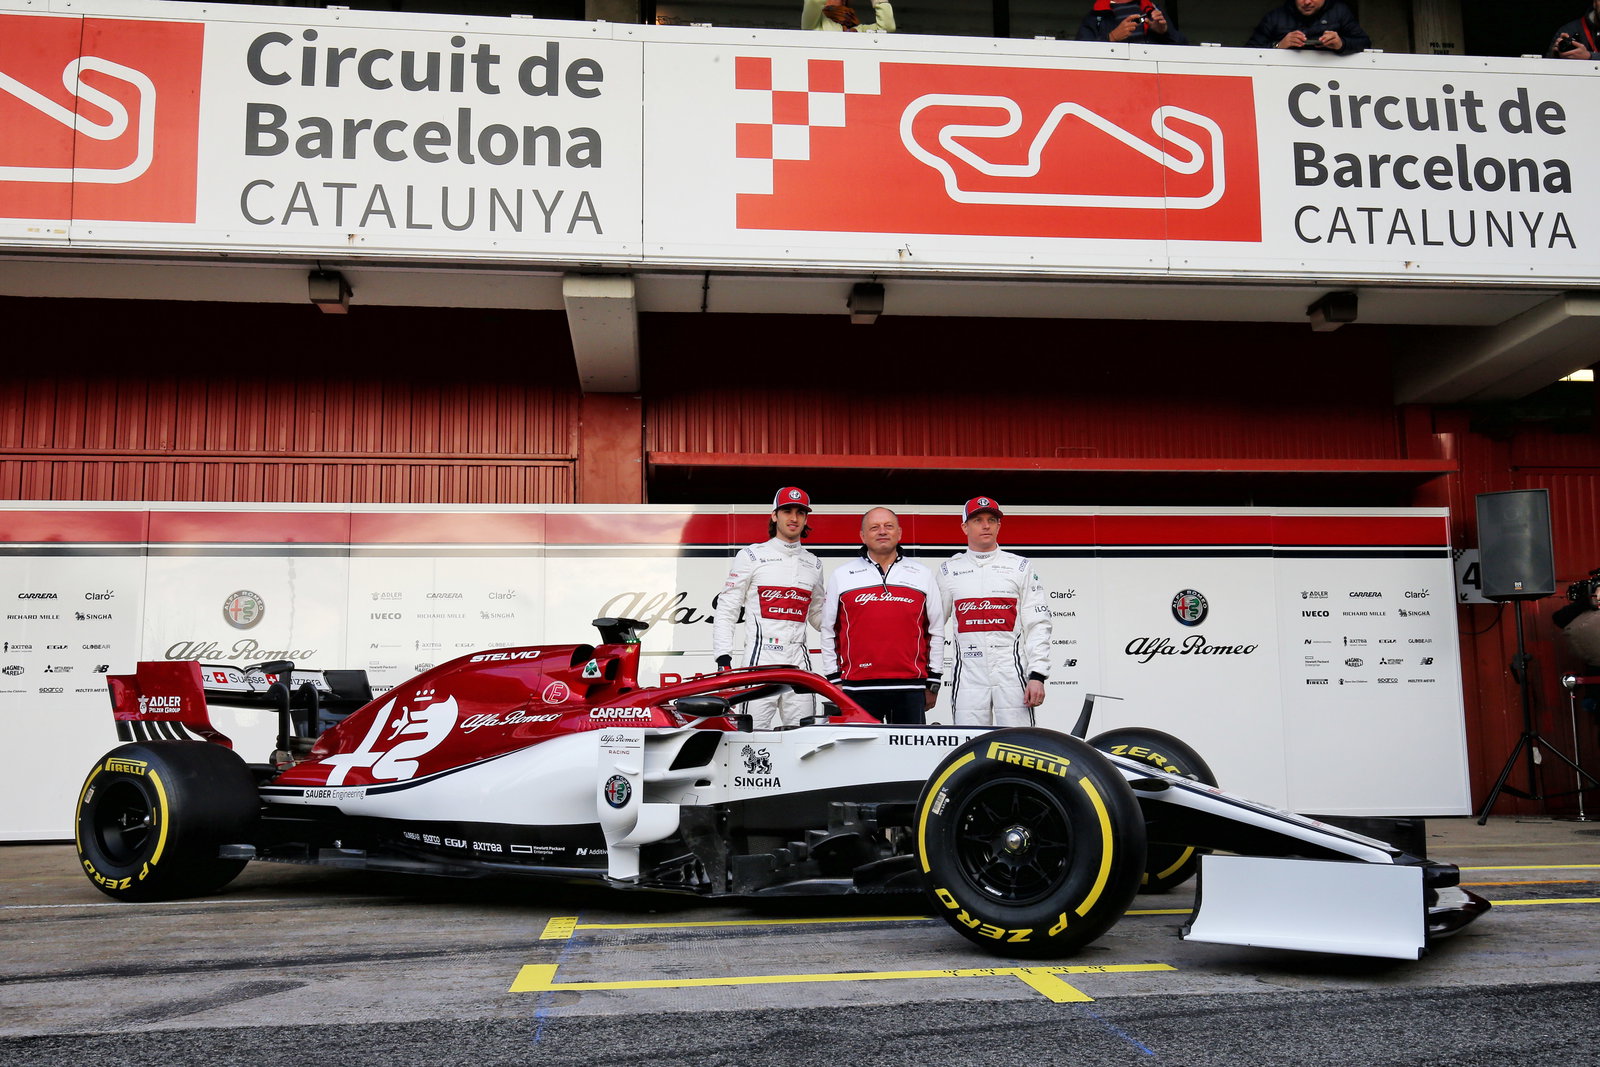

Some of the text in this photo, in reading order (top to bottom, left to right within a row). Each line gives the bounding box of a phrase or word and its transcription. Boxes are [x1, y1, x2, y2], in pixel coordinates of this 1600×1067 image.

[246, 29, 605, 98] Circuit de
[1287, 82, 1566, 136] Circuit de
[244, 102, 603, 168] Barcelona
[1294, 142, 1574, 194] Barcelona
[239, 179, 604, 235] CATALUNYA
[1294, 204, 1577, 250] CATALUNYA
[1462, 562, 1481, 590] 4
[85, 592, 111, 600] Claro
[488, 591, 512, 600] Claro
[761, 589, 810, 602] Alfa Romeo
[854, 592, 914, 606] Alfa Romeo
[1172, 590, 1208, 609] ALFA ROMEO
[768, 606, 803, 615] GIULIA
[958, 600, 1012, 614] Alfa Romeo
[164, 638, 317, 660] Alfa Romeo
[469, 649, 542, 663] STELVIO
[1125, 635, 1259, 664] Alfa Romeo
[149, 696, 181, 707] ADLER
[589, 707, 652, 718] CARRERA
[459, 710, 563, 734] Alfa Romeo
[600, 734, 640, 745] Alfa Romeo
[889, 735, 959, 746] RICHARD
[105, 757, 148, 775] PIRELLI
[986, 741, 1071, 778] PIRELLI
[734, 776, 781, 788] SINGHA
[305, 789, 365, 800] SAUBER Engineering
[423, 834, 441, 845] sparco
[83, 859, 150, 890] P ZERO
[934, 888, 1068, 943] P ZERO
